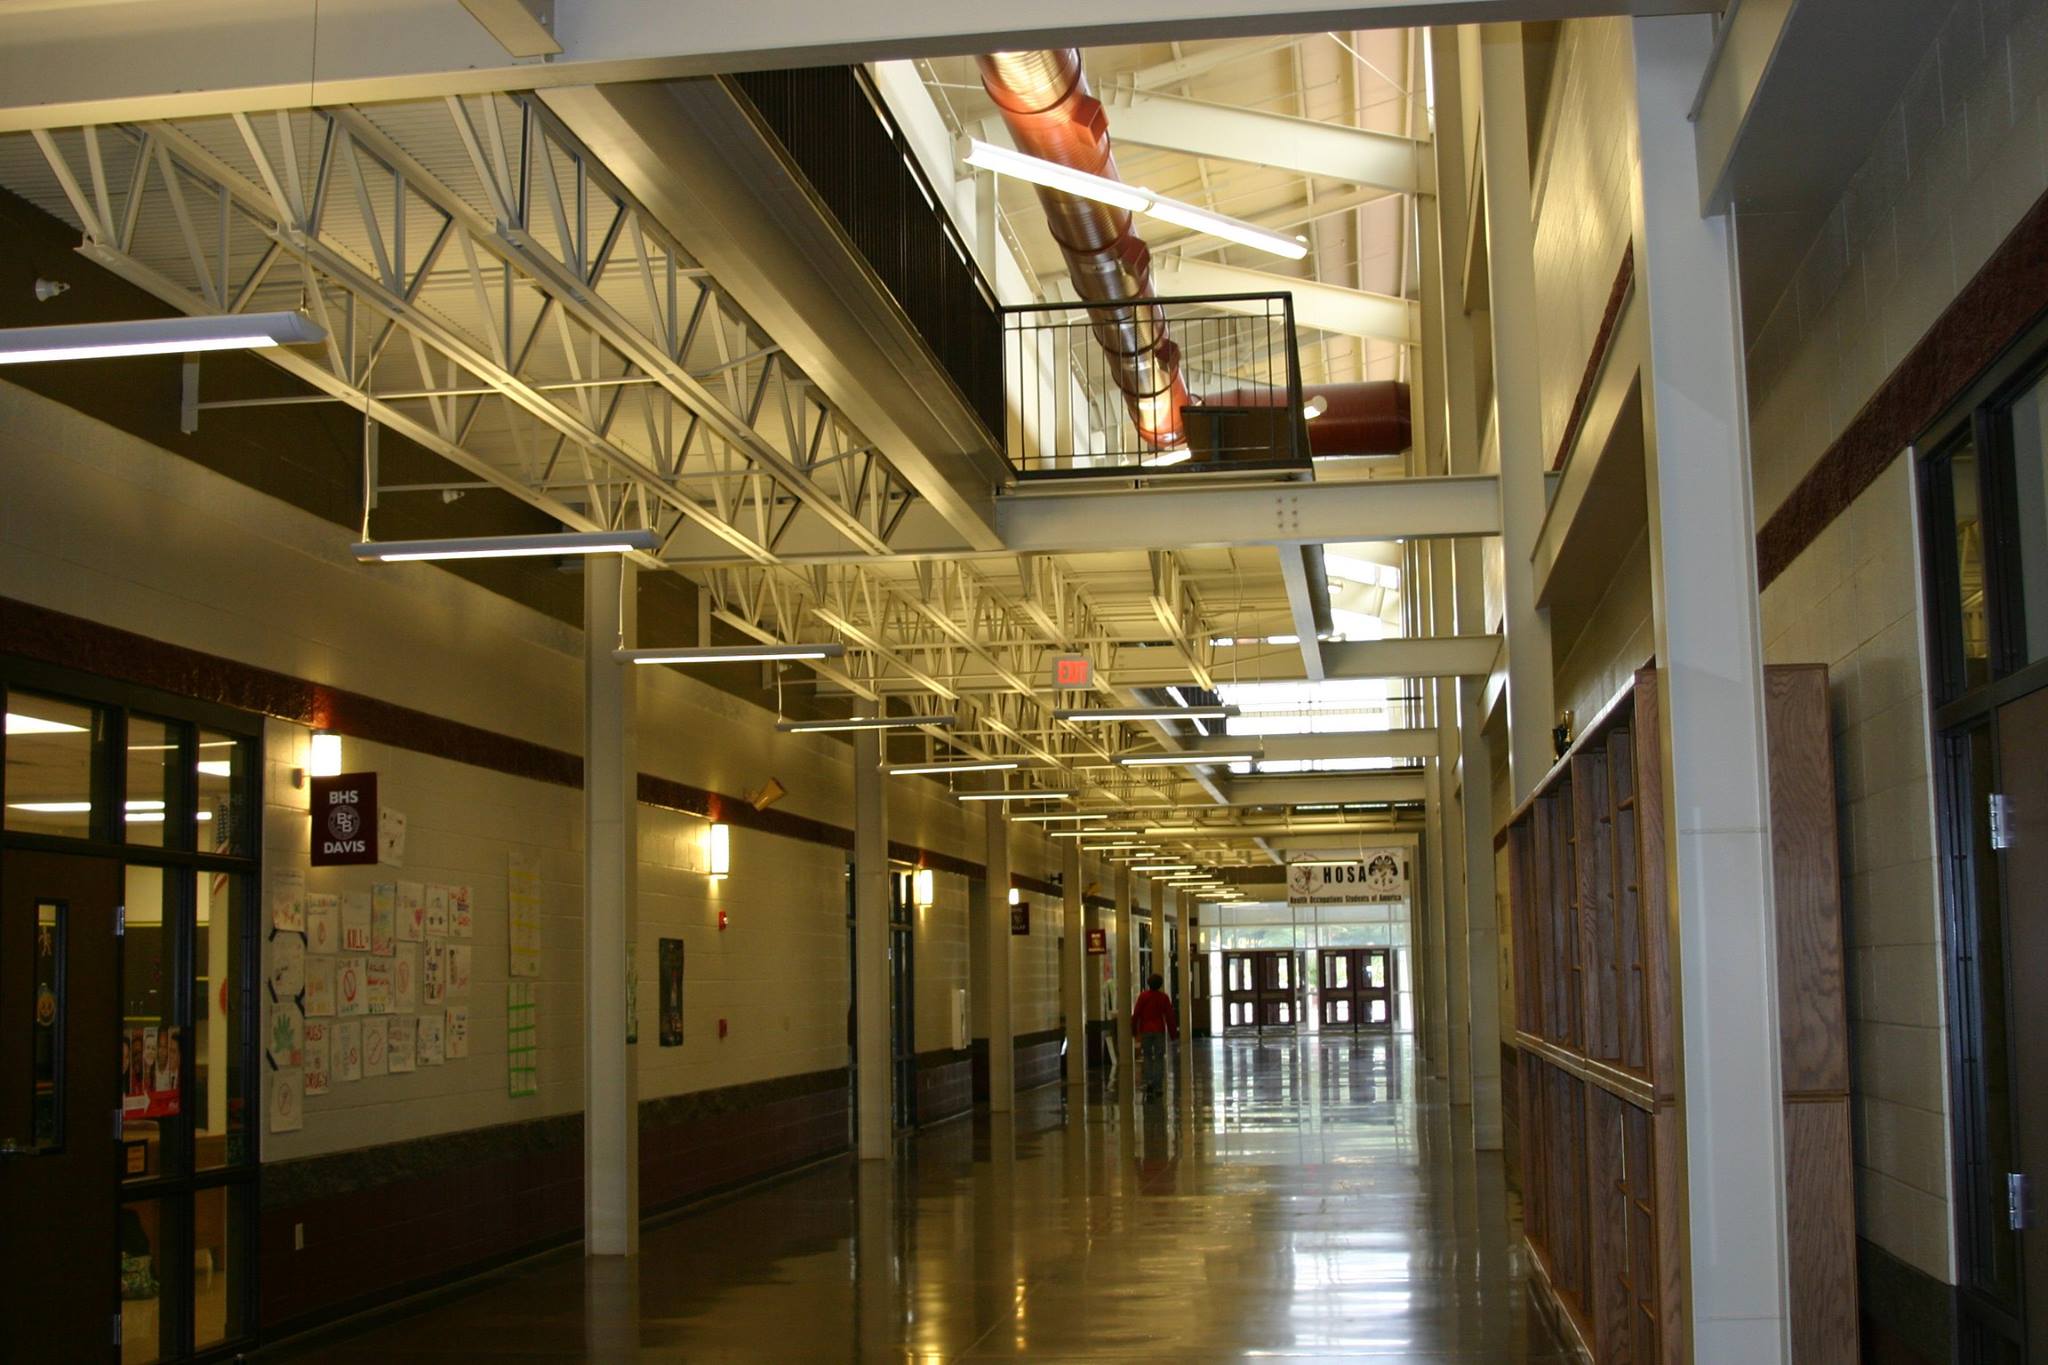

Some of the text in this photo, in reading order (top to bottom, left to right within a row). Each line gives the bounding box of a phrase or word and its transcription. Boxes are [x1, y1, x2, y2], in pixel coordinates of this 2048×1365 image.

[328, 790, 359, 805] BHS
[323, 840, 366, 854] DAVIS
[1323, 865, 1367, 884] HOSA
[1345, 895, 1370, 903] Students
[1379, 894, 1402, 902] America
